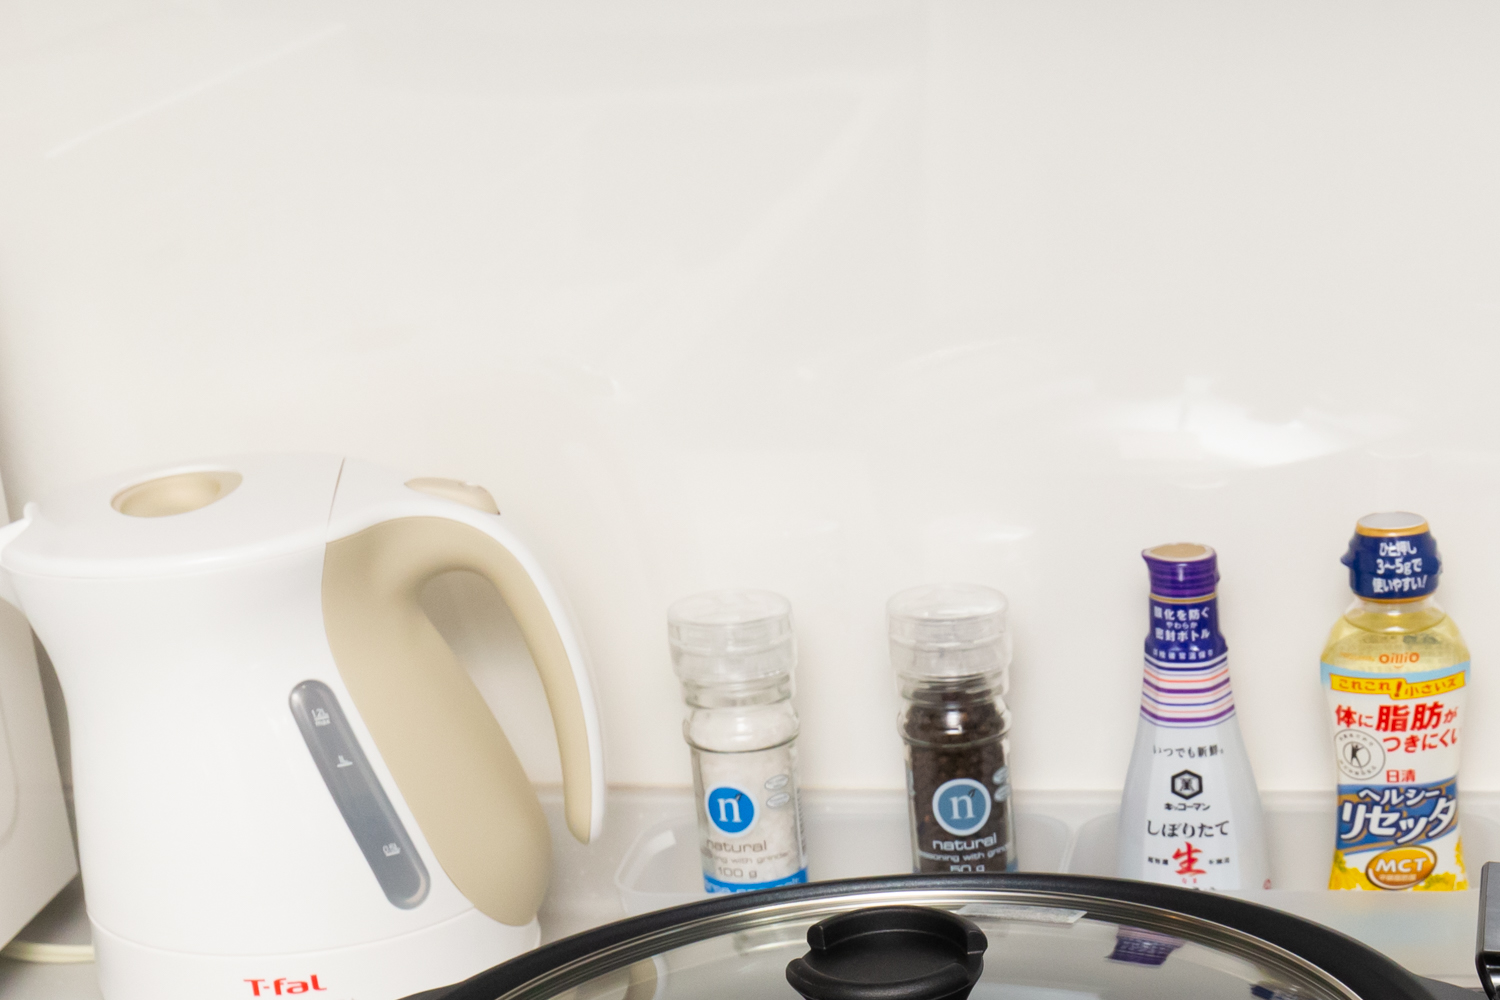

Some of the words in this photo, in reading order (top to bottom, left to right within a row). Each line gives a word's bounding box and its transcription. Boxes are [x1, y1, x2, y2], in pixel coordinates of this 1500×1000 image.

[1335, 700, 1459, 733] 体に脂肪が
[1386, 769, 1416, 783] 日清
[1357, 787, 1442, 807] ヘルシー
[1146, 819, 1230, 839] しぼりたて
[1339, 796, 1457, 844] リセッタ
[706, 839, 767, 853] natural
[932, 832, 998, 852] natural
[1171, 841, 1207, 876] 生
[1374, 857, 1428, 873] MCT
[243, 974, 327, 997] T-fal
